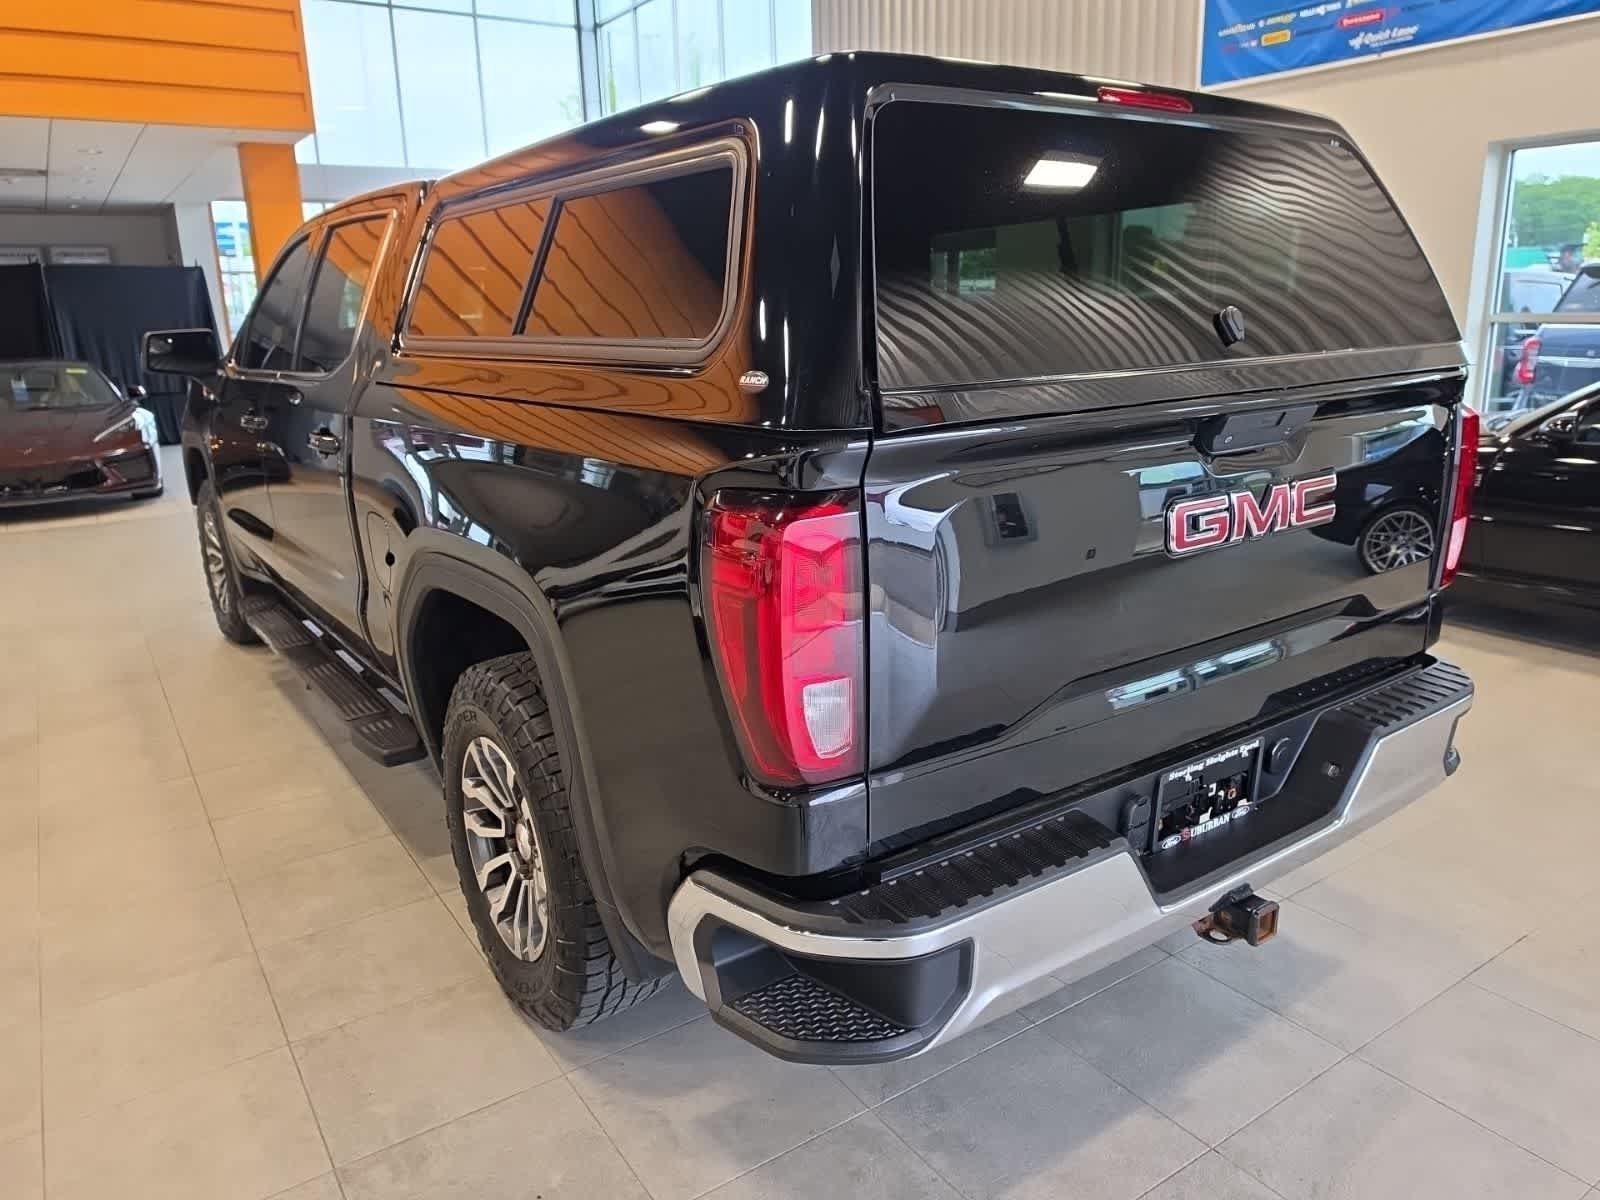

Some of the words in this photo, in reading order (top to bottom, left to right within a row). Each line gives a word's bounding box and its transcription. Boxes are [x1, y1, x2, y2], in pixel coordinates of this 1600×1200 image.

[739, 375, 768, 386] RANCH
[1171, 474, 1337, 553] GMC
[1205, 748, 1239, 767] Heights
[1181, 812, 1231, 841] SUBURBAN
